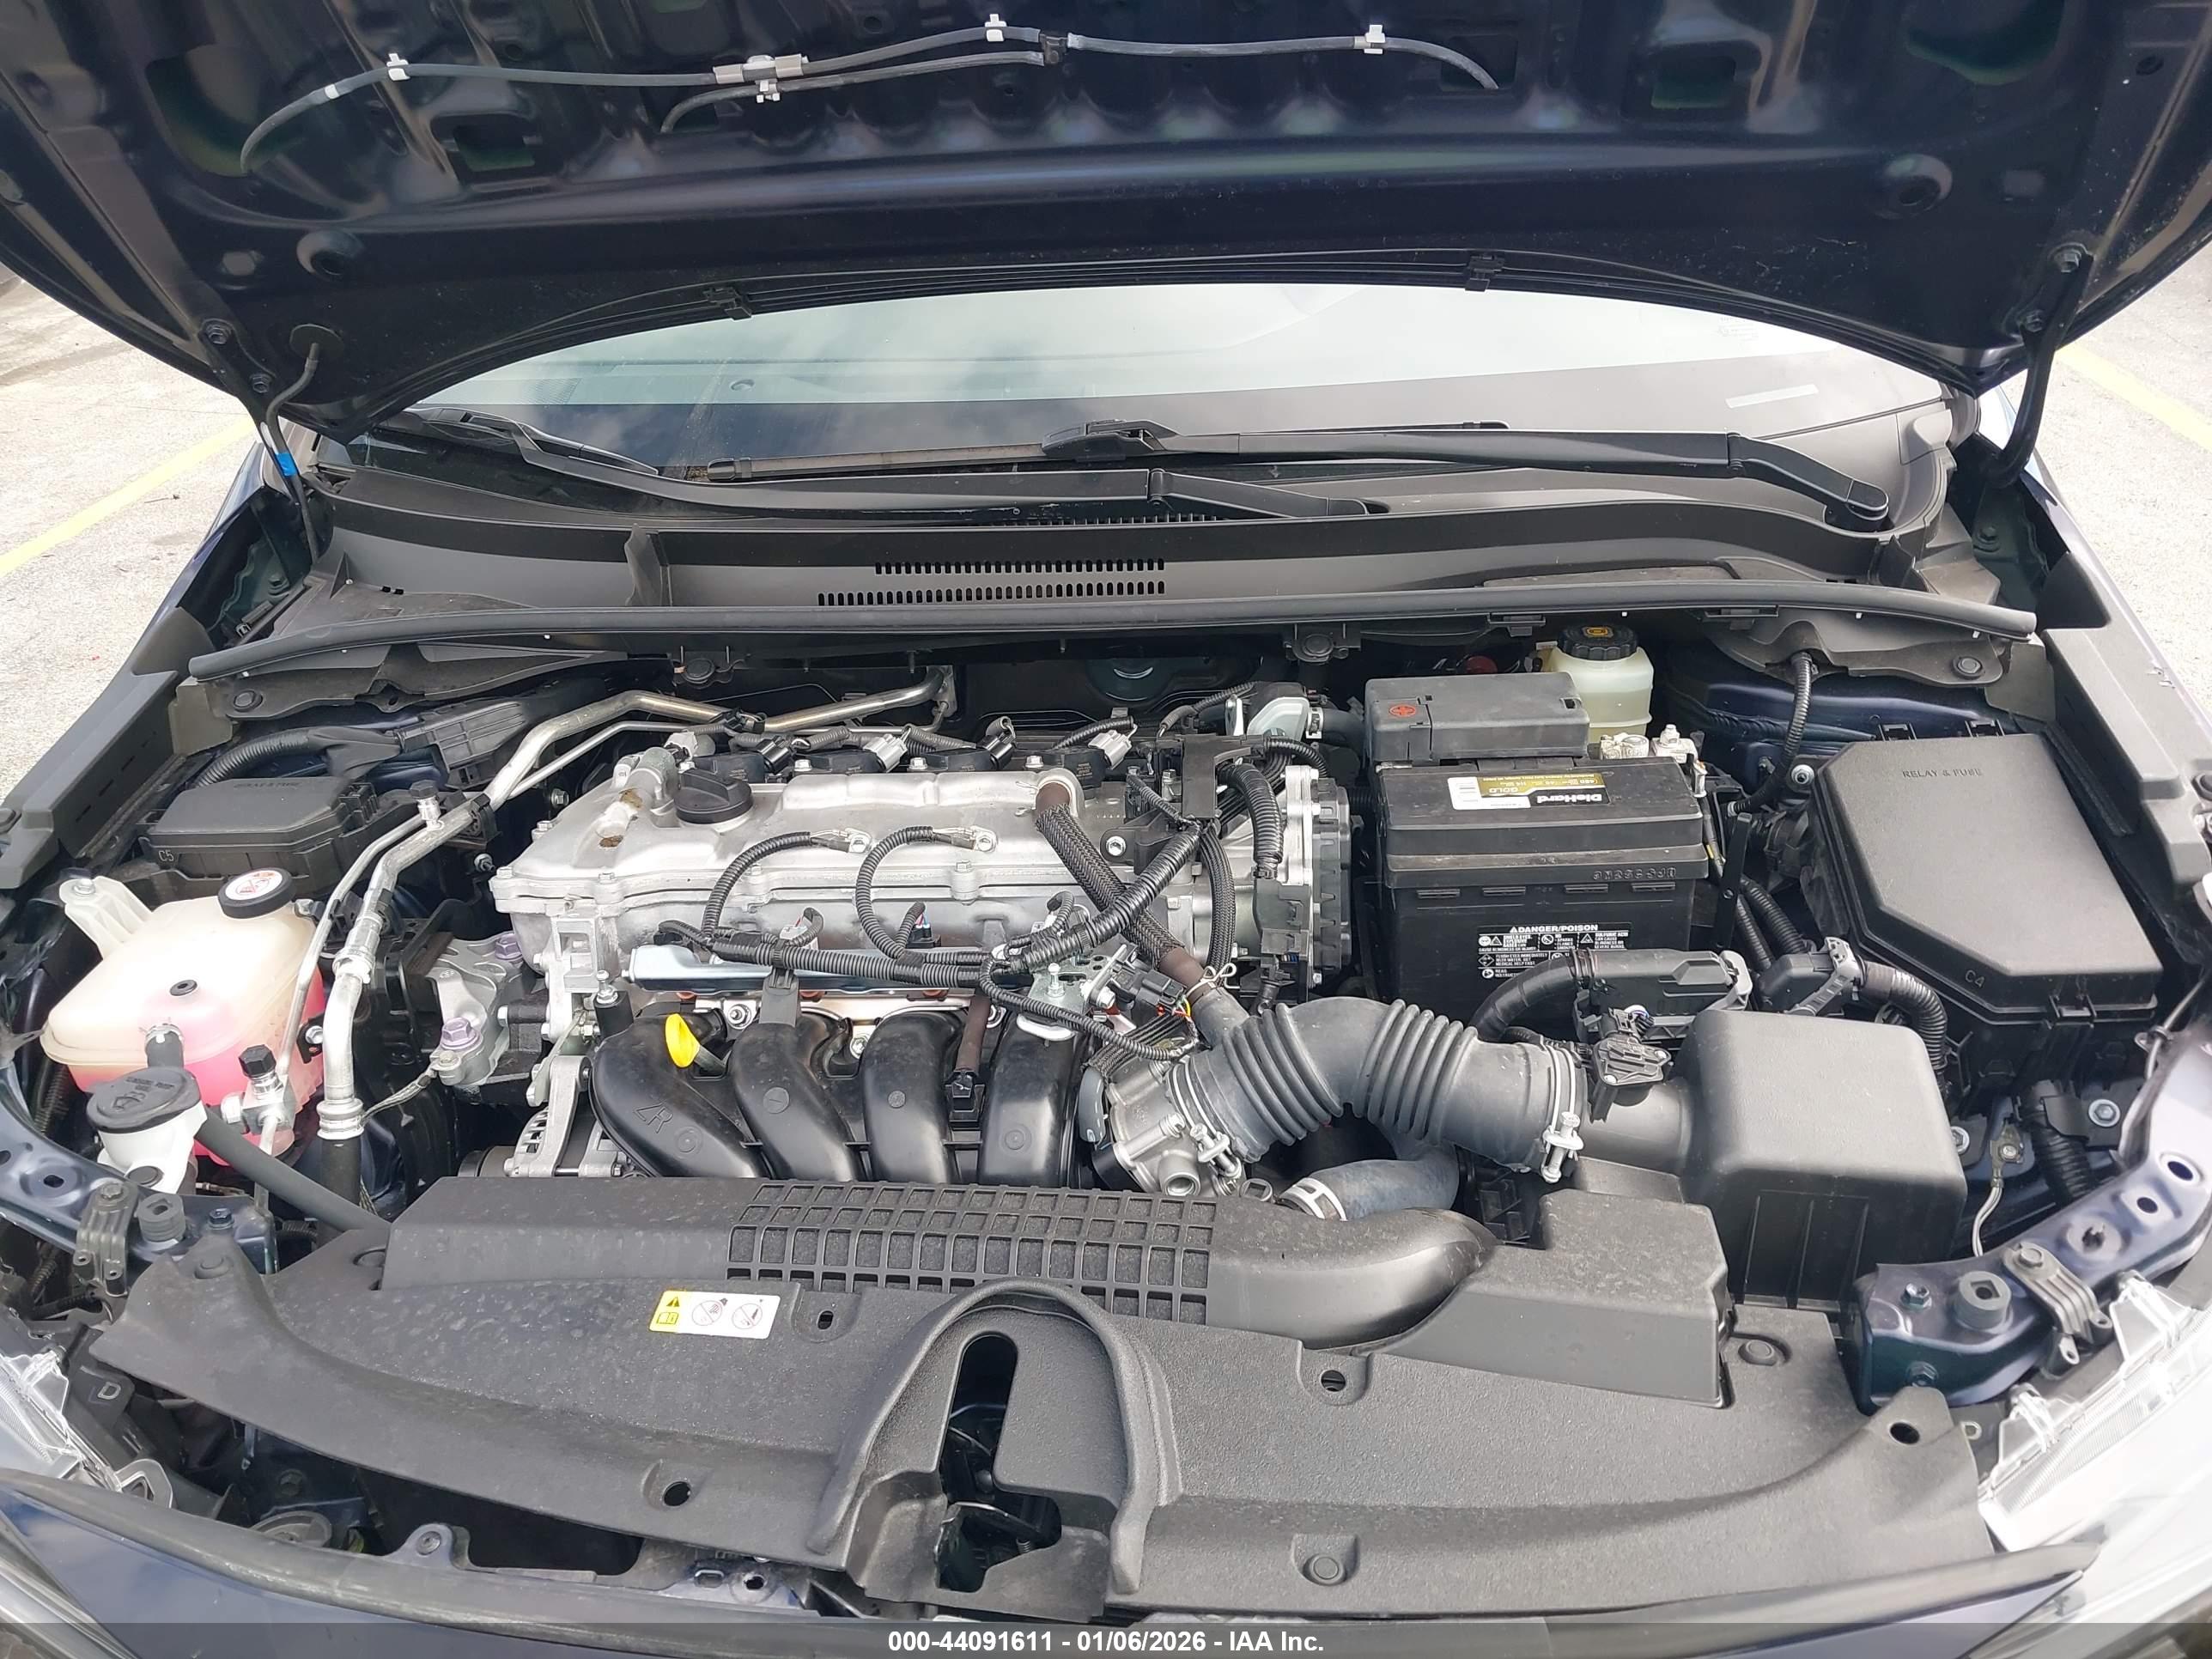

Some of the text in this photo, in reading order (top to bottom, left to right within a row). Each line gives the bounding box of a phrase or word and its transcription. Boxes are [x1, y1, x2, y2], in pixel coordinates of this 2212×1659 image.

[1902, 769, 1937, 778] RELAY
[1954, 769, 1982, 777] FUSE
[1537, 793, 1602, 804] DieHard
[158, 849, 174, 862] C5
[1518, 924, 1599, 933] DANGER/POISON
[1965, 969, 1984, 988] C4
